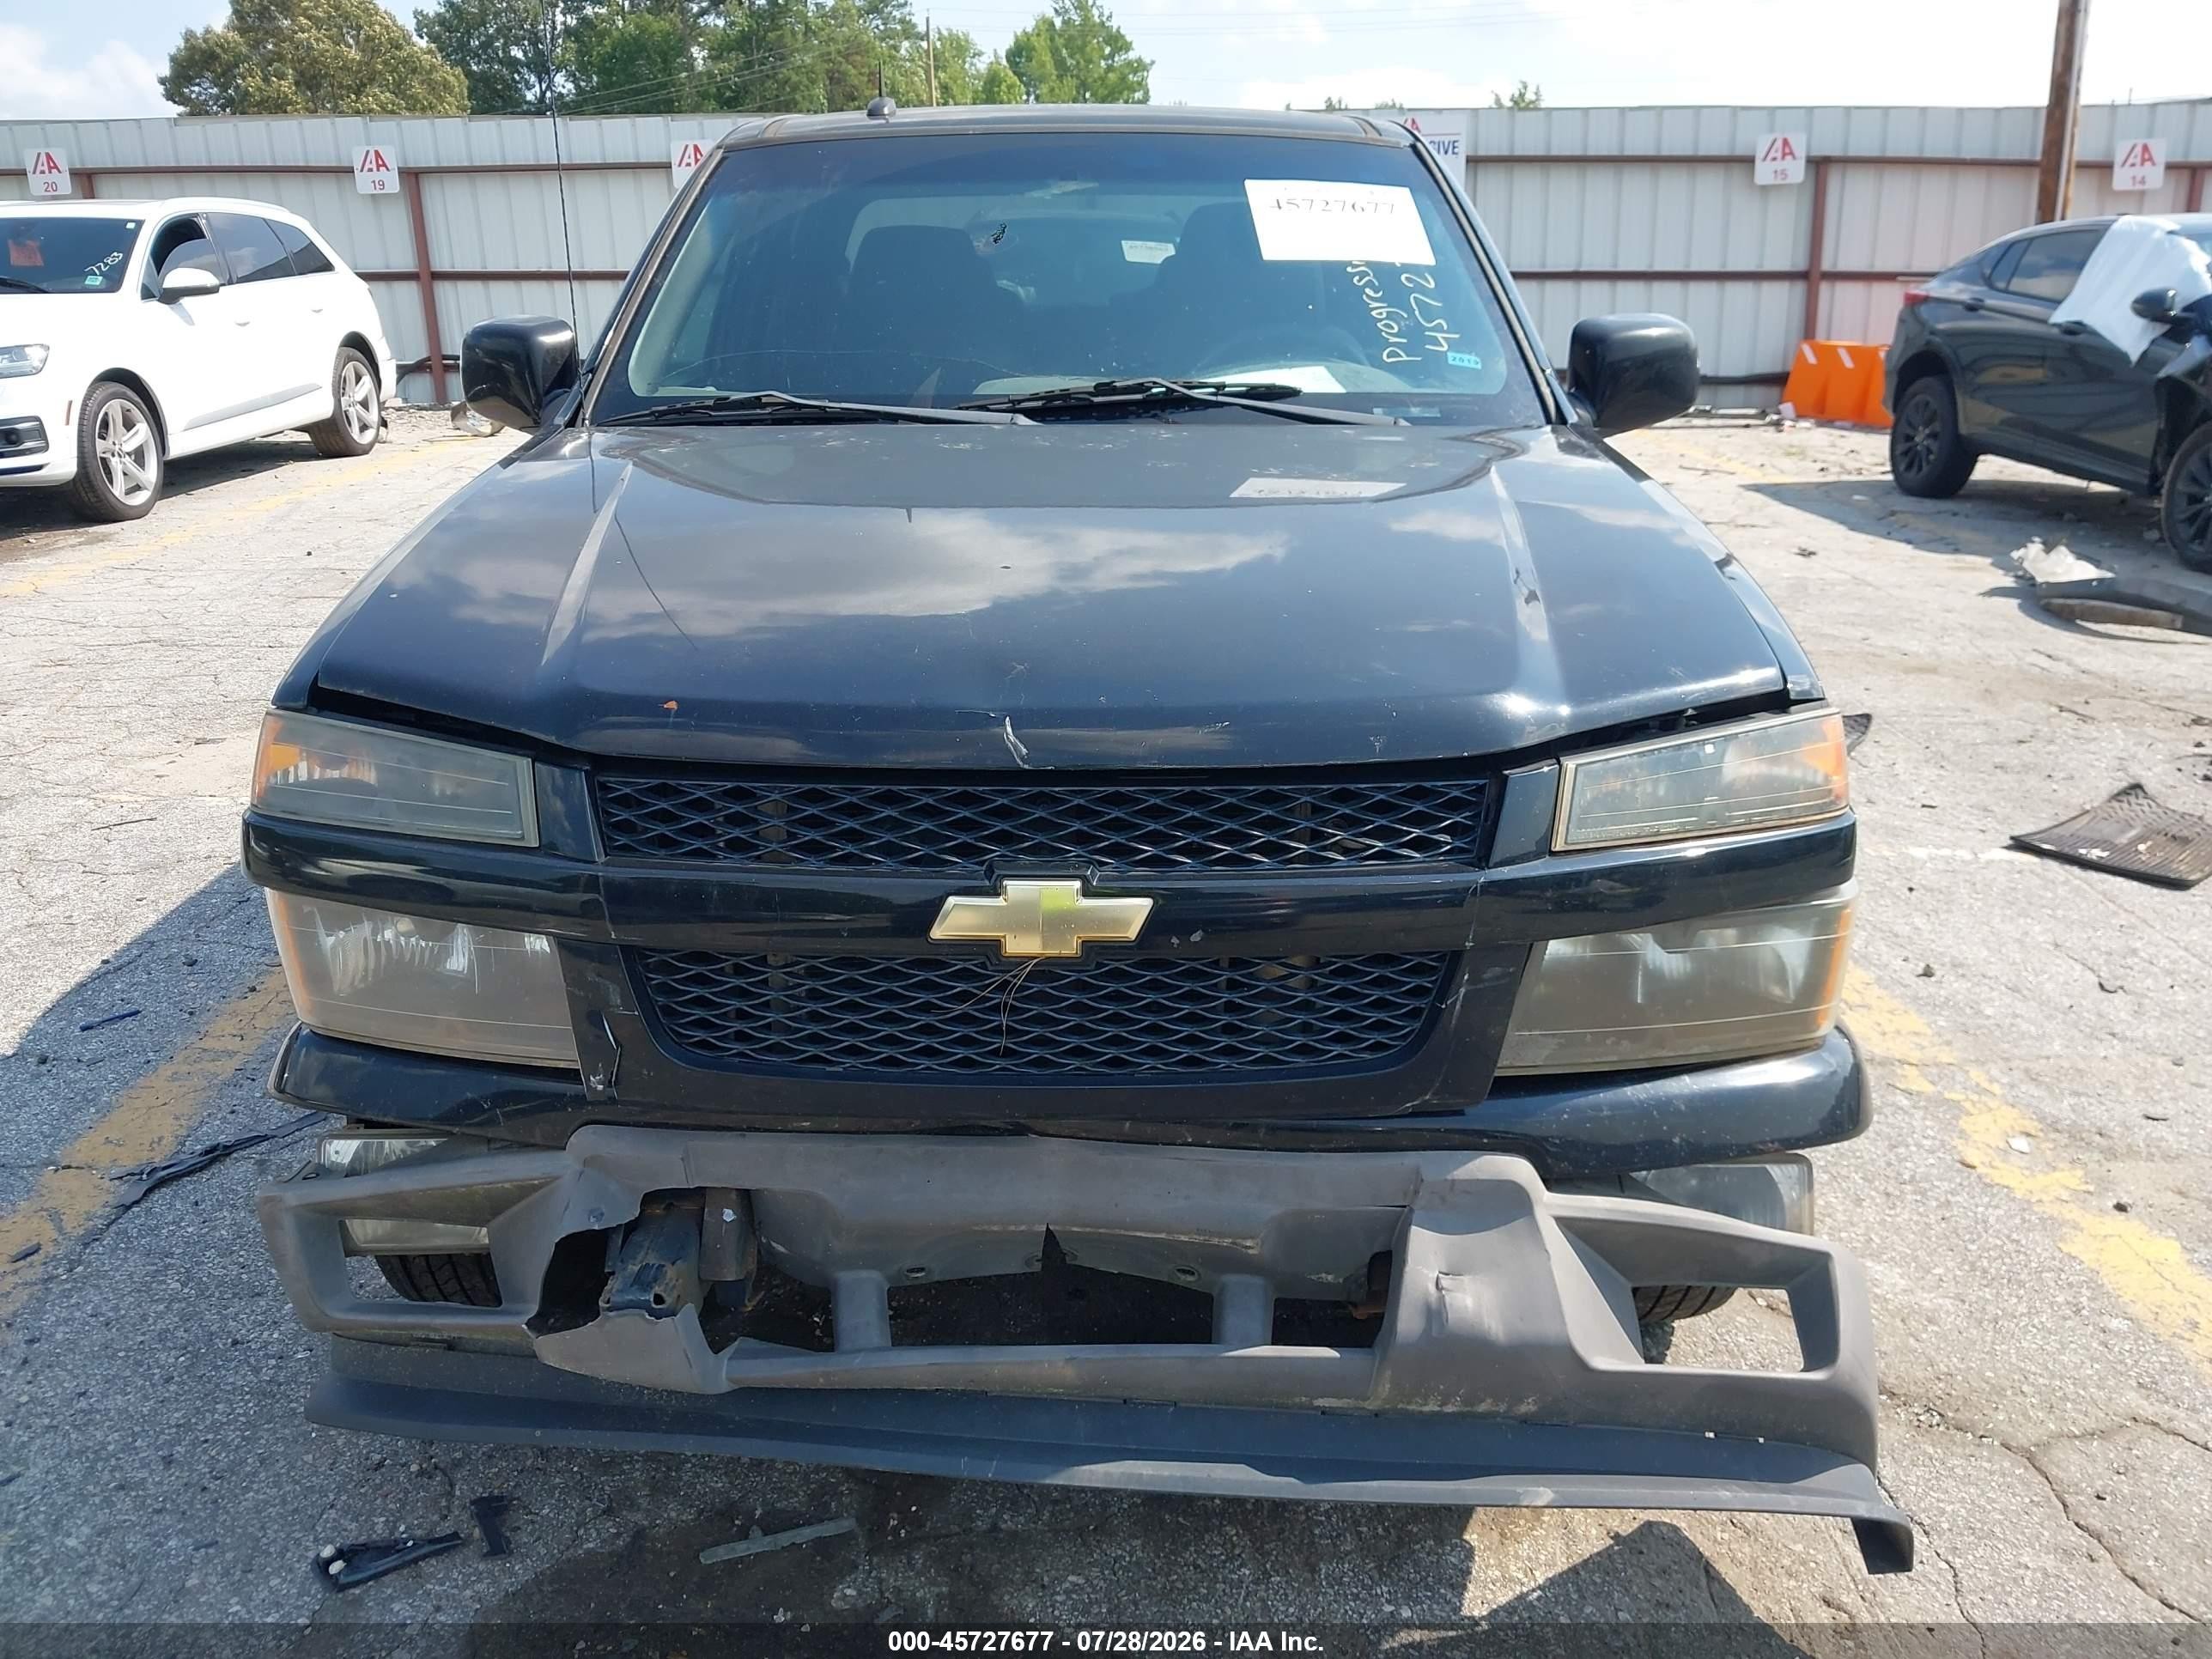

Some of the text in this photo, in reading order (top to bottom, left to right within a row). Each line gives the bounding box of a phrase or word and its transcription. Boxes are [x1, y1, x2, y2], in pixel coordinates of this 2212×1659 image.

[1771, 168, 1789, 181] 15
[2130, 174, 2147, 187] 14
[43, 181, 58, 192] 20
[370, 179, 386, 191] 19
[83, 252, 124, 276] 7283
[1395, 261, 1461, 352] 4572
